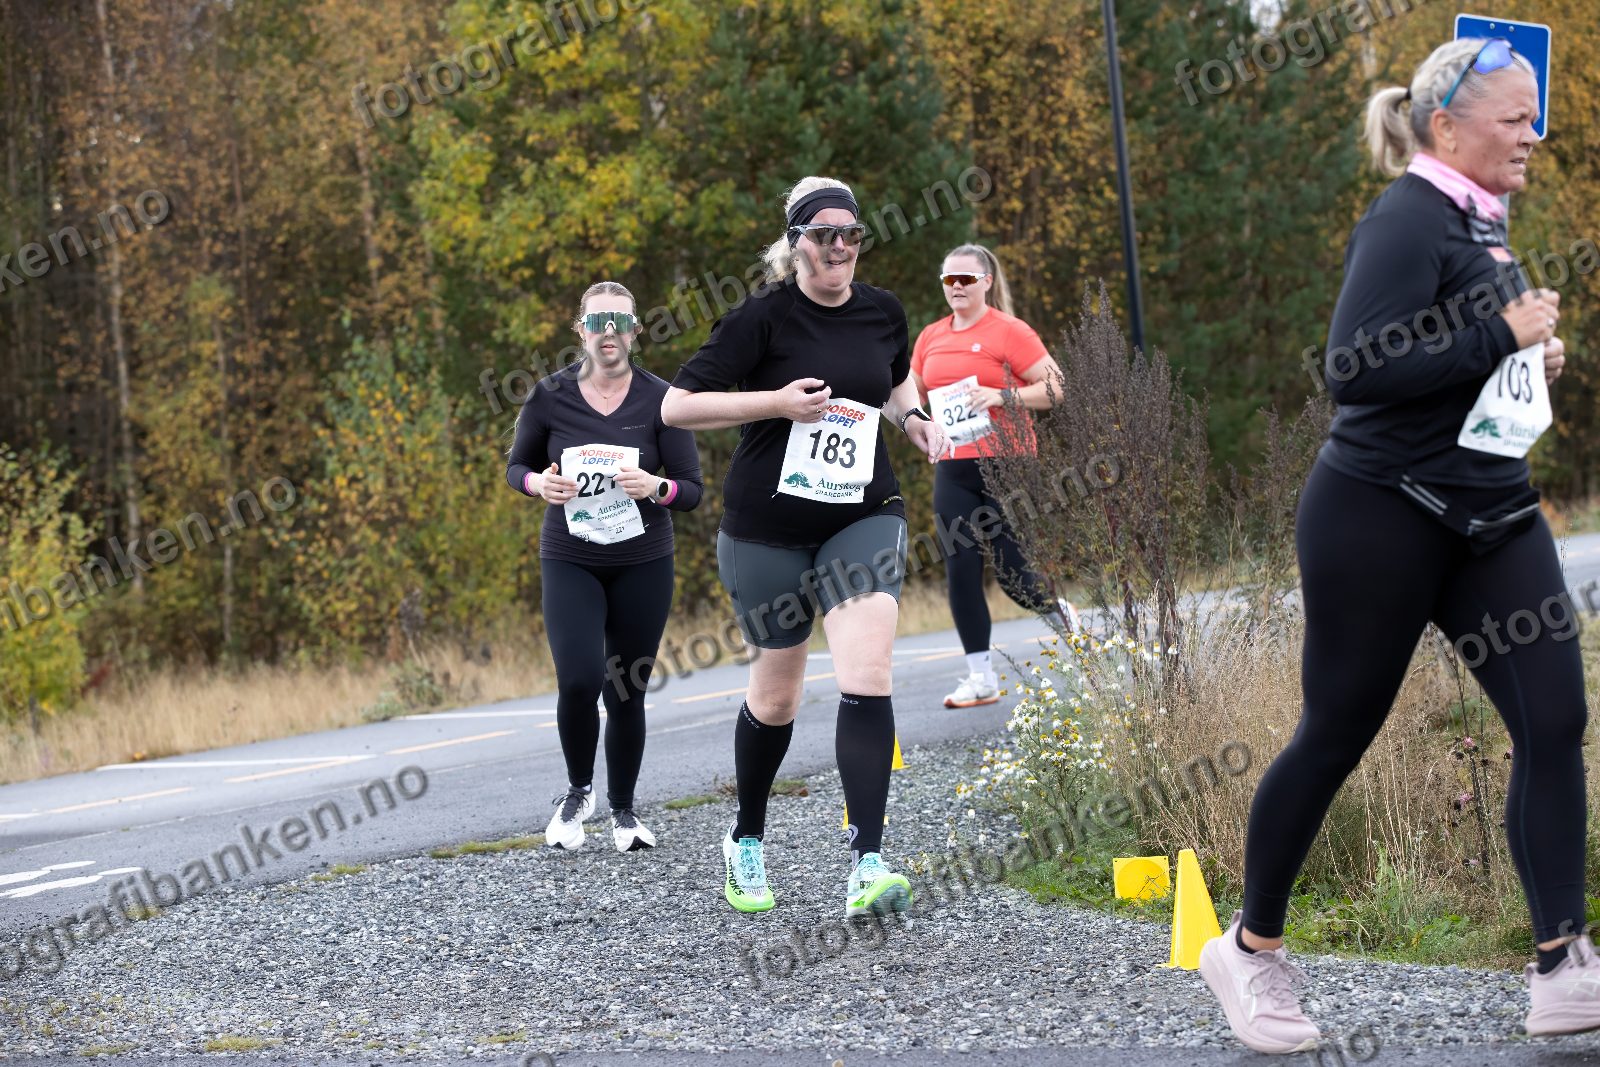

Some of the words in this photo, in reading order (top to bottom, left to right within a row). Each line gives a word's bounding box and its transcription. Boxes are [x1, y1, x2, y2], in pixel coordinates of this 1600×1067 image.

[578, 449, 625, 460] NORGES
[809, 429, 857, 469] 183
[582, 457, 617, 466] LØPET
[816, 477, 862, 493] Aurskog
[597, 498, 634, 516] Aurskog
